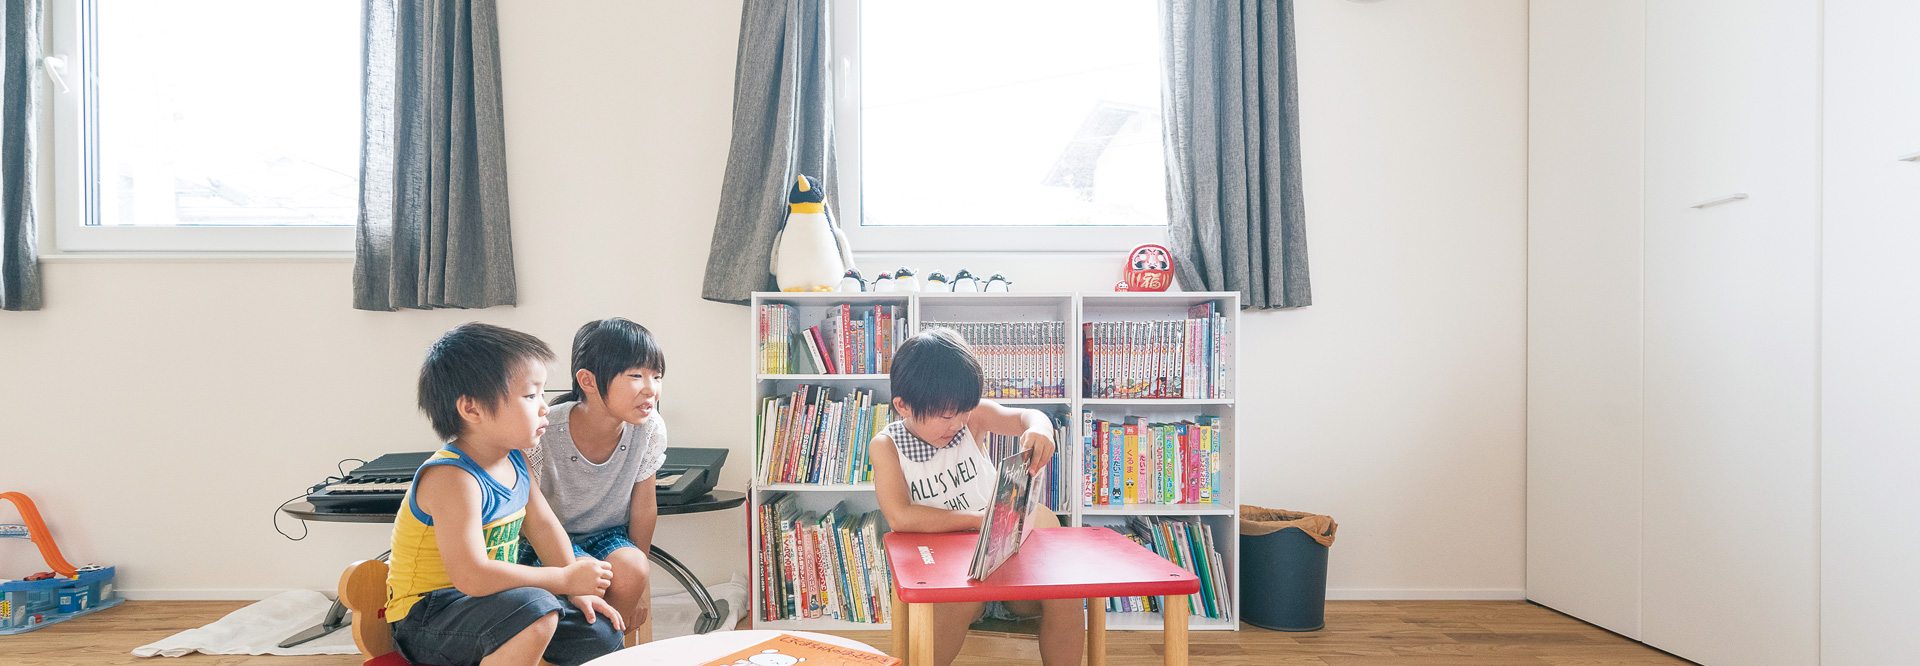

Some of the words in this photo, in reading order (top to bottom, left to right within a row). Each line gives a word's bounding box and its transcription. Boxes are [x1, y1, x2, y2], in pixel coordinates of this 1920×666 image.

[1140, 272, 1162, 290] 福
[1126, 449, 1134, 473] くるま
[910, 472, 947, 501] ALL'S
